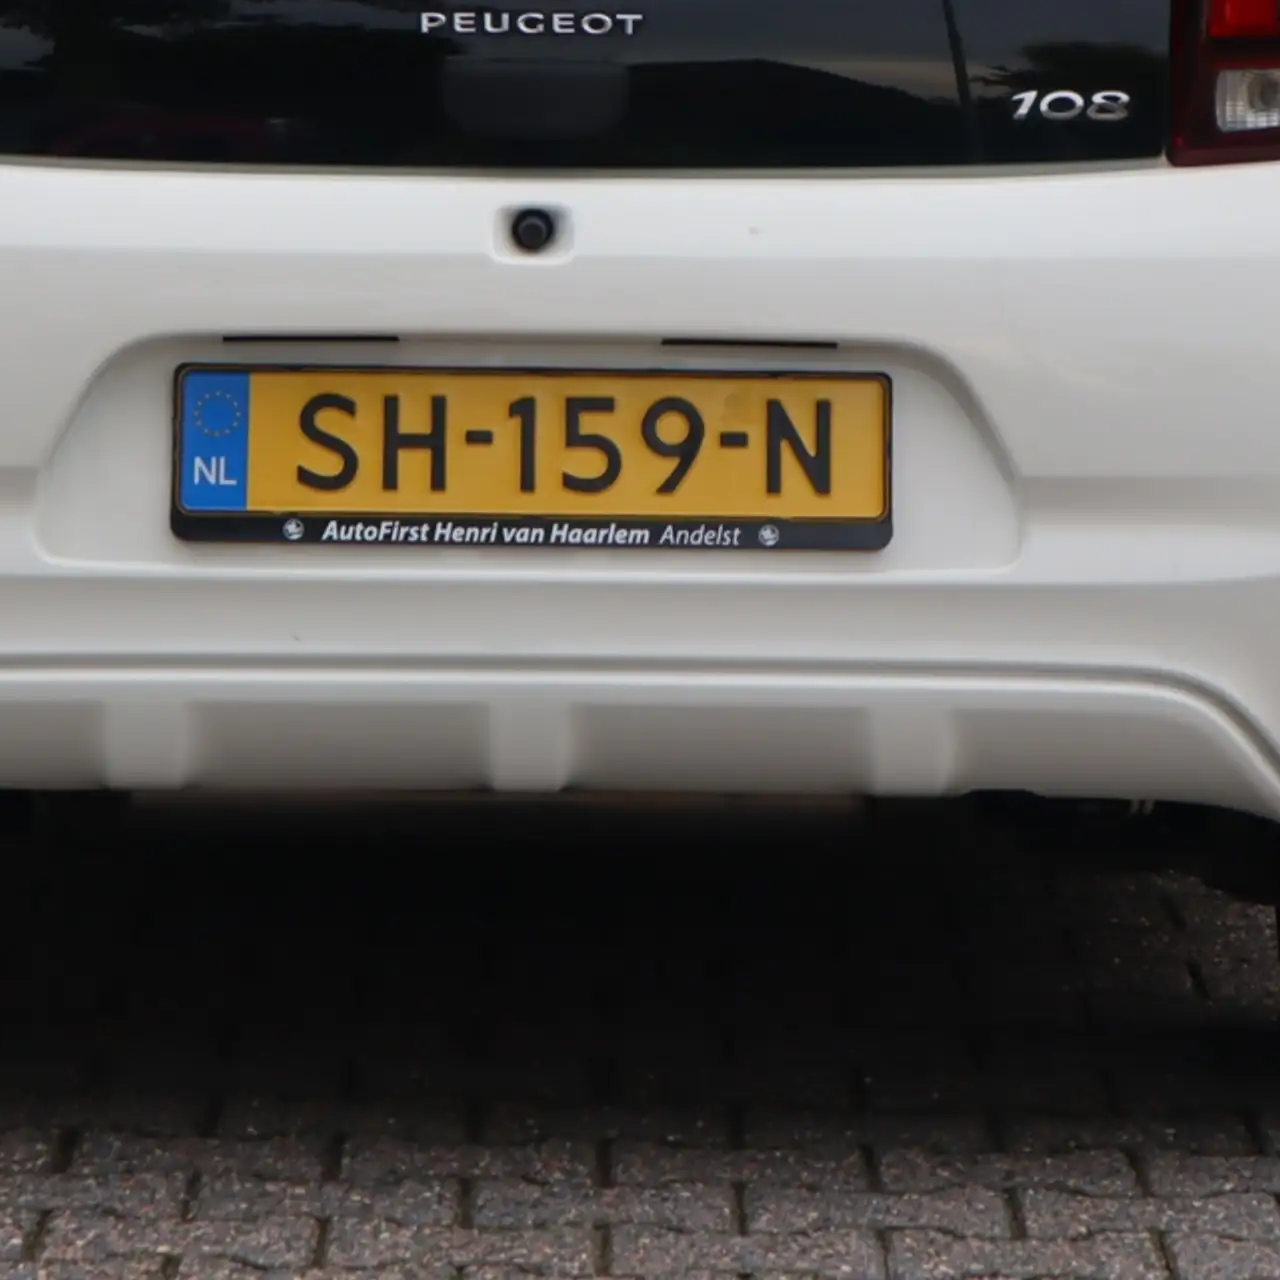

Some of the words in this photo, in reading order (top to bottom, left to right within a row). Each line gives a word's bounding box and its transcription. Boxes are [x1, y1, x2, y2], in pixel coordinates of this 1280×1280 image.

[420, 11, 644, 36] PEUGEOT
[1011, 90, 1131, 121] 108
[193, 456, 237, 486] NL
[296, 392, 832, 496] SH-159-N
[321, 520, 430, 543] AutoFirst
[434, 521, 497, 544] Henri
[502, 527, 544, 545] van
[549, 522, 650, 547] Haarlem
[658, 524, 741, 547] Andelst
